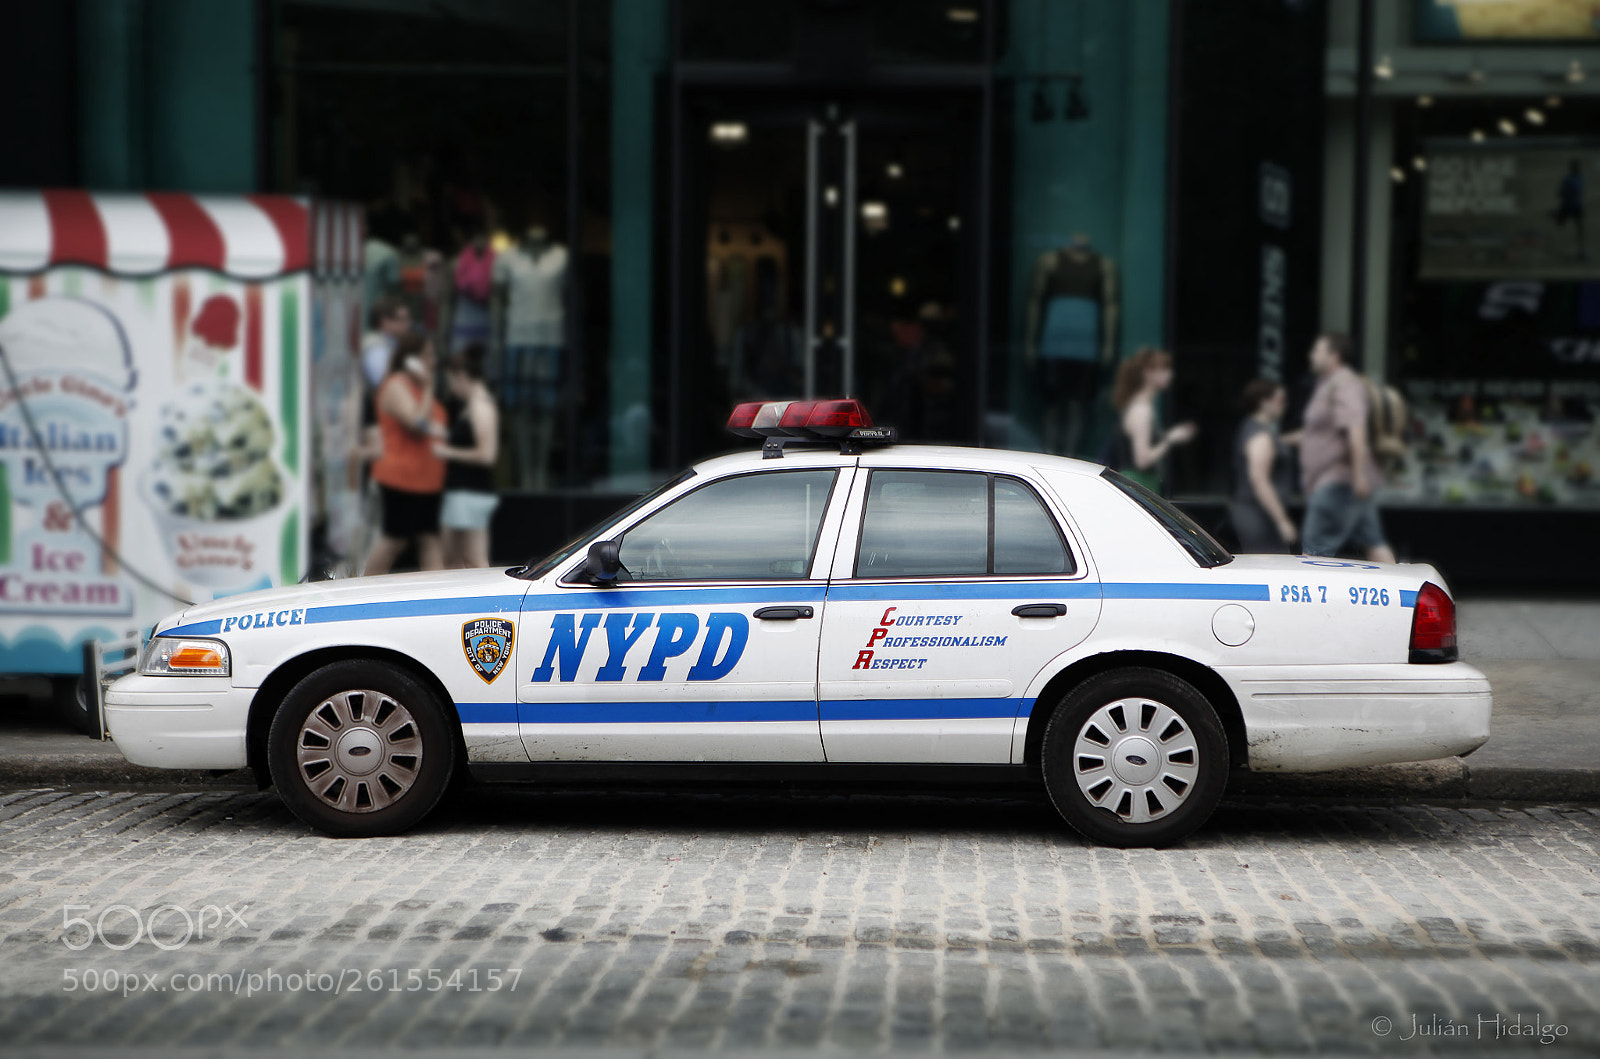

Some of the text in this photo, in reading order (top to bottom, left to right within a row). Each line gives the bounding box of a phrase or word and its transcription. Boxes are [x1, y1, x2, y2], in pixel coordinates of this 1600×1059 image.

[31, 544, 85, 571] Ice
[0, 574, 119, 604] Cream
[1280, 585, 1390, 607] PSA 7 9726
[223, 608, 304, 633] POLICE
[475, 620, 502, 628] POLICE
[880, 606, 963, 627] COURTESY
[465, 628, 511, 639] DEPARTMENT
[866, 627, 1008, 648] PROFESSIONALISM
[466, 641, 512, 675] CITY OF NEW YORK
[531, 612, 749, 683] NYPD
[852, 650, 927, 670] RESPECT
